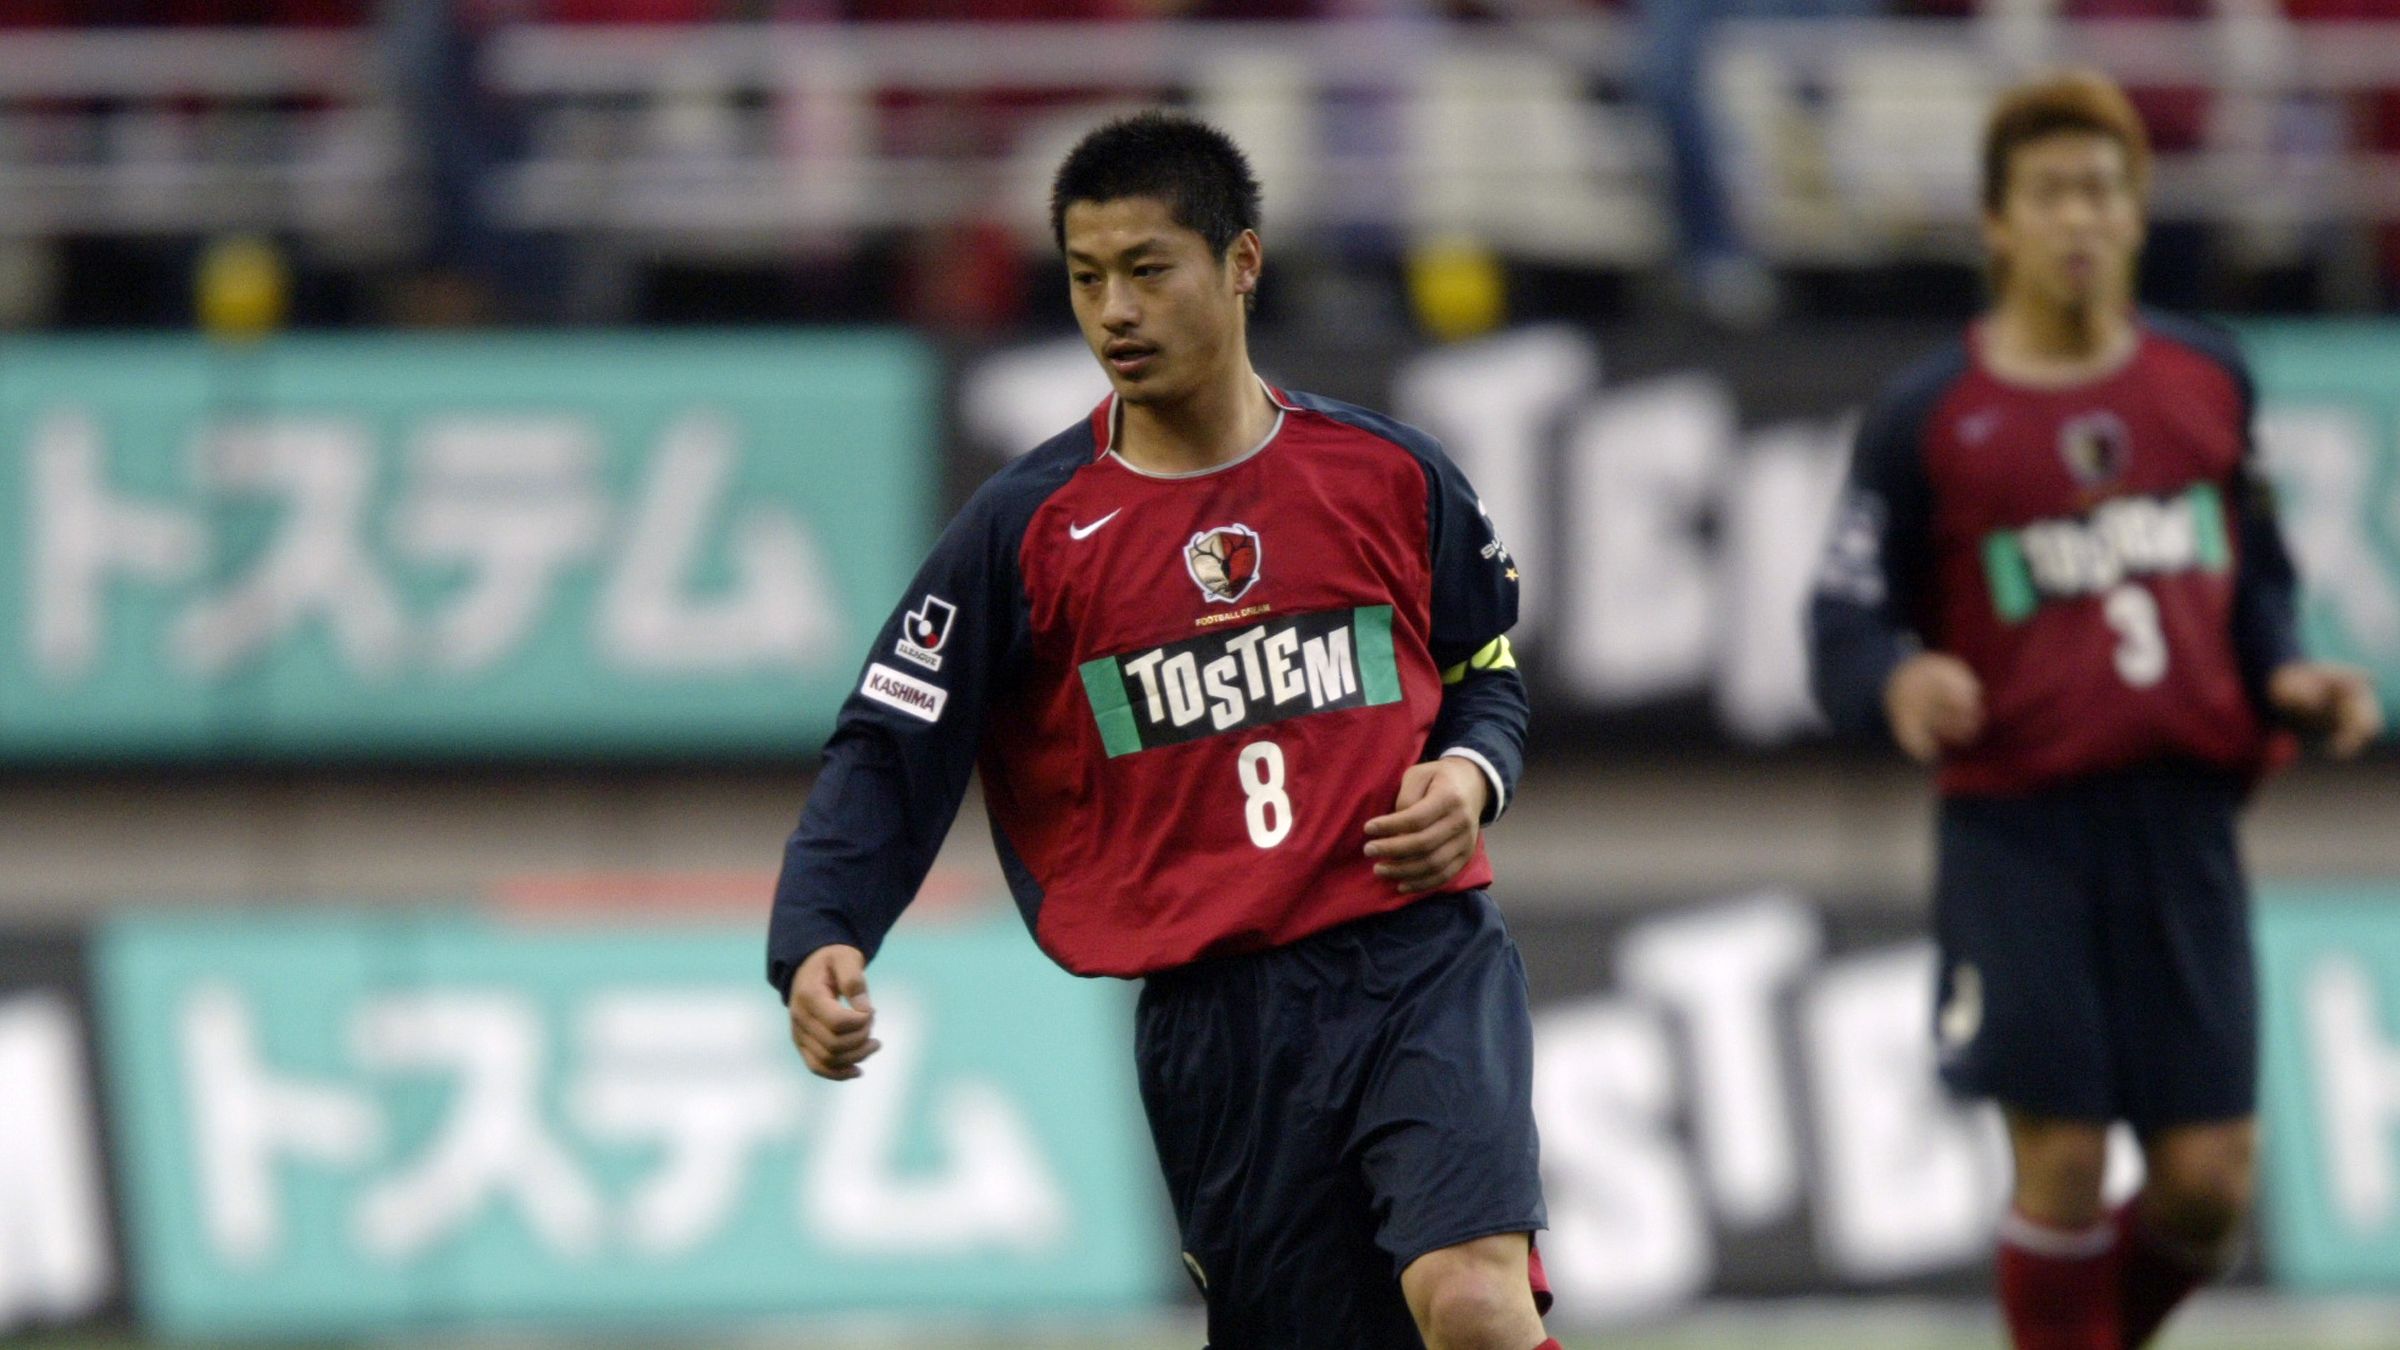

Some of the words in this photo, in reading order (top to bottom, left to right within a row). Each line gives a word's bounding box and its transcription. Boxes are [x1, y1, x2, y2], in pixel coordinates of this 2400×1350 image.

[28, 408, 840, 685] トステム
[1195, 611, 1240, 626] FOOTBALL
[2105, 585, 2168, 689] 3
[870, 673, 936, 712] KASHIMA
[1126, 625, 1357, 730] TOSTEM
[1238, 741, 1292, 849] 8
[182, 980, 1066, 1270] トステム
